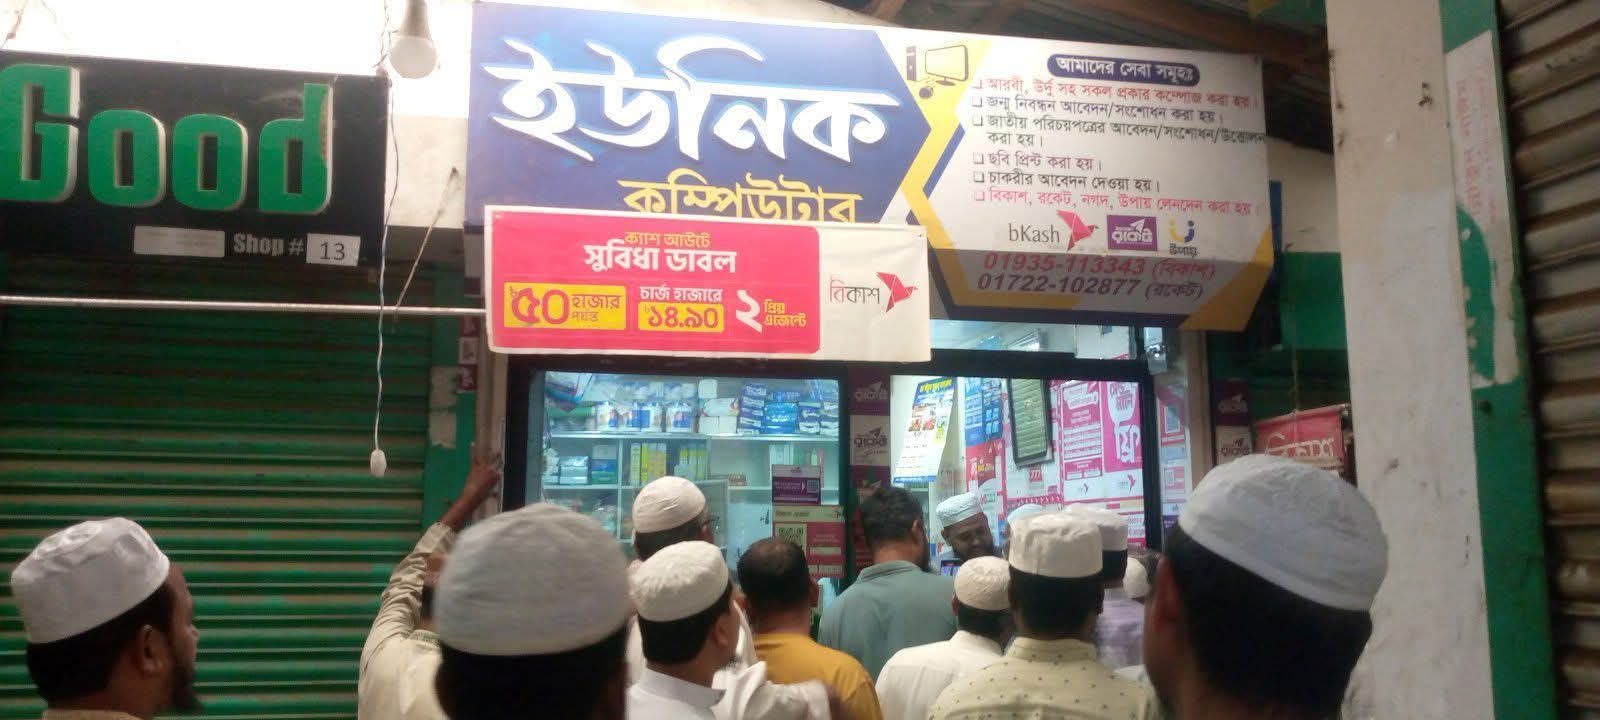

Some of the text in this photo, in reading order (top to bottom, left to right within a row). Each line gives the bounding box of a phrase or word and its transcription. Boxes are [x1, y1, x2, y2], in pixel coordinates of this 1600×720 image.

[1056, 57, 1116, 75] আমাদের
[1120, 61, 1150, 78] সেবা
[481, 36, 901, 162] ইউনিক
[1058, 83, 1075, 96] সহ
[1081, 84, 1112, 97] সকল
[1117, 86, 1150, 100] প্রকার
[1207, 93, 1229, 106] করা
[986, 96, 1010, 110] জন্ম
[1015, 94, 1057, 112] নিবন্ধন
[1060, 99, 1167, 119] আবেদন/সংশোধন
[1171, 108, 1194, 121] করা
[986, 112, 1028, 129] জাতীয়
[1032, 114, 1106, 134] পরিচয়পত্রের
[0, 63, 335, 214] Good
[986, 132, 1012, 145] করা
[987, 150, 1010, 165] ছবি
[1015, 150, 1041, 168] প্রিন্ট
[1046, 156, 1071, 169] করা
[987, 168, 1033, 186] চাকরীর
[1038, 173, 1088, 188] আবেদন
[1091, 176, 1130, 191] দেওয়া
[617, 168, 863, 223] কম্পিউটার
[1118, 193, 1152, 210] উপায়
[1207, 200, 1230, 213] করা
[624, 231, 711, 248] ক্যাশ আউটে
[1008, 223, 1061, 244] bKash
[233, 231, 284, 257] Shop
[318, 240, 346, 261] 13
[584, 238, 737, 273] সুবিধা ডাবল
[983, 250, 1217, 282] 01935-113343 (বিকাশ)
[639, 283, 722, 302] চার্জ হাজারে
[829, 278, 880, 304] বিকাশ
[977, 272, 1142, 296] 01722-102877
[571, 293, 622, 310] হাজার
[736, 289, 786, 334] ২ প্রিয়
